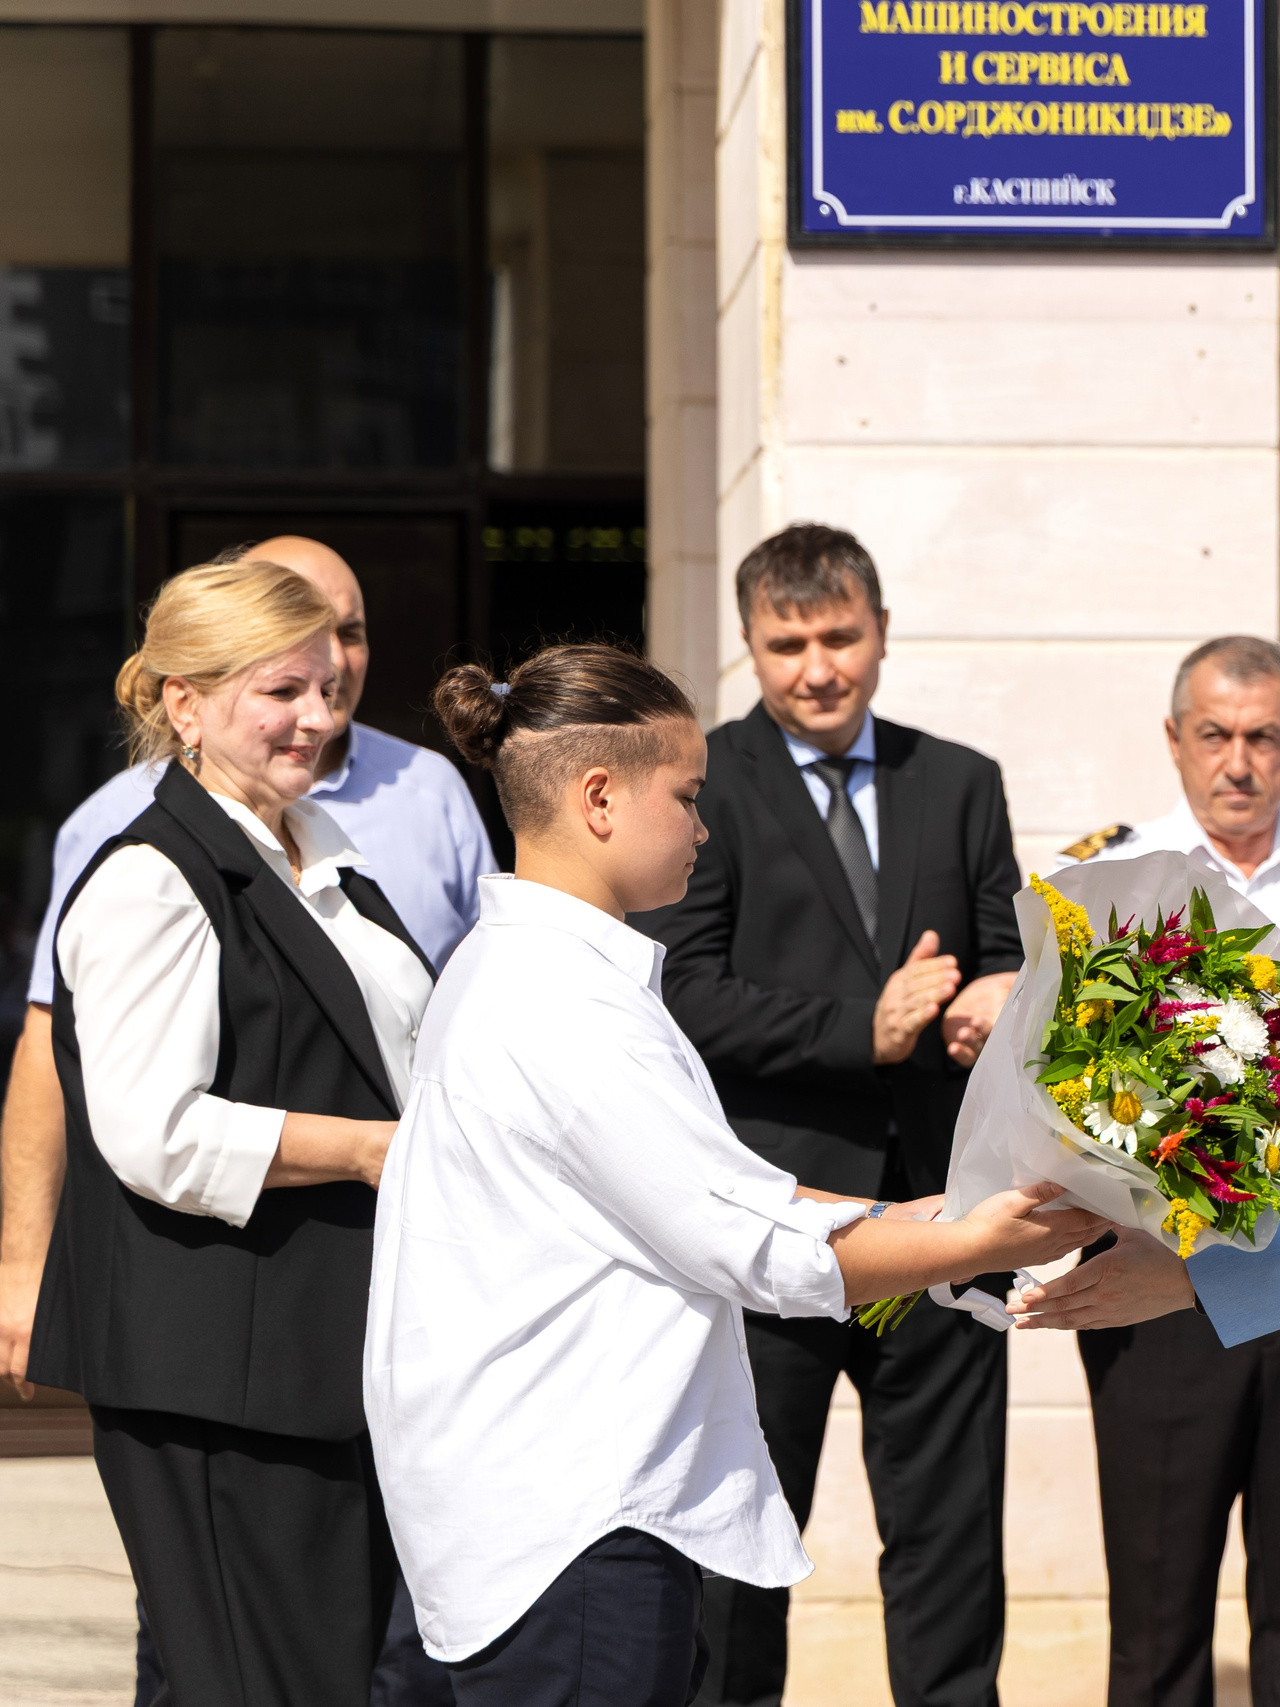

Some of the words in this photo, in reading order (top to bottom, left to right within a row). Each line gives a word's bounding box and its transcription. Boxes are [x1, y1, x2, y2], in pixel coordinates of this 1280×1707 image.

[859, 1, 1209, 37] МАШИНОСТРОЕНИЯ
[939, 51, 968, 85] И
[972, 52, 1131, 86] СЕРВИСА
